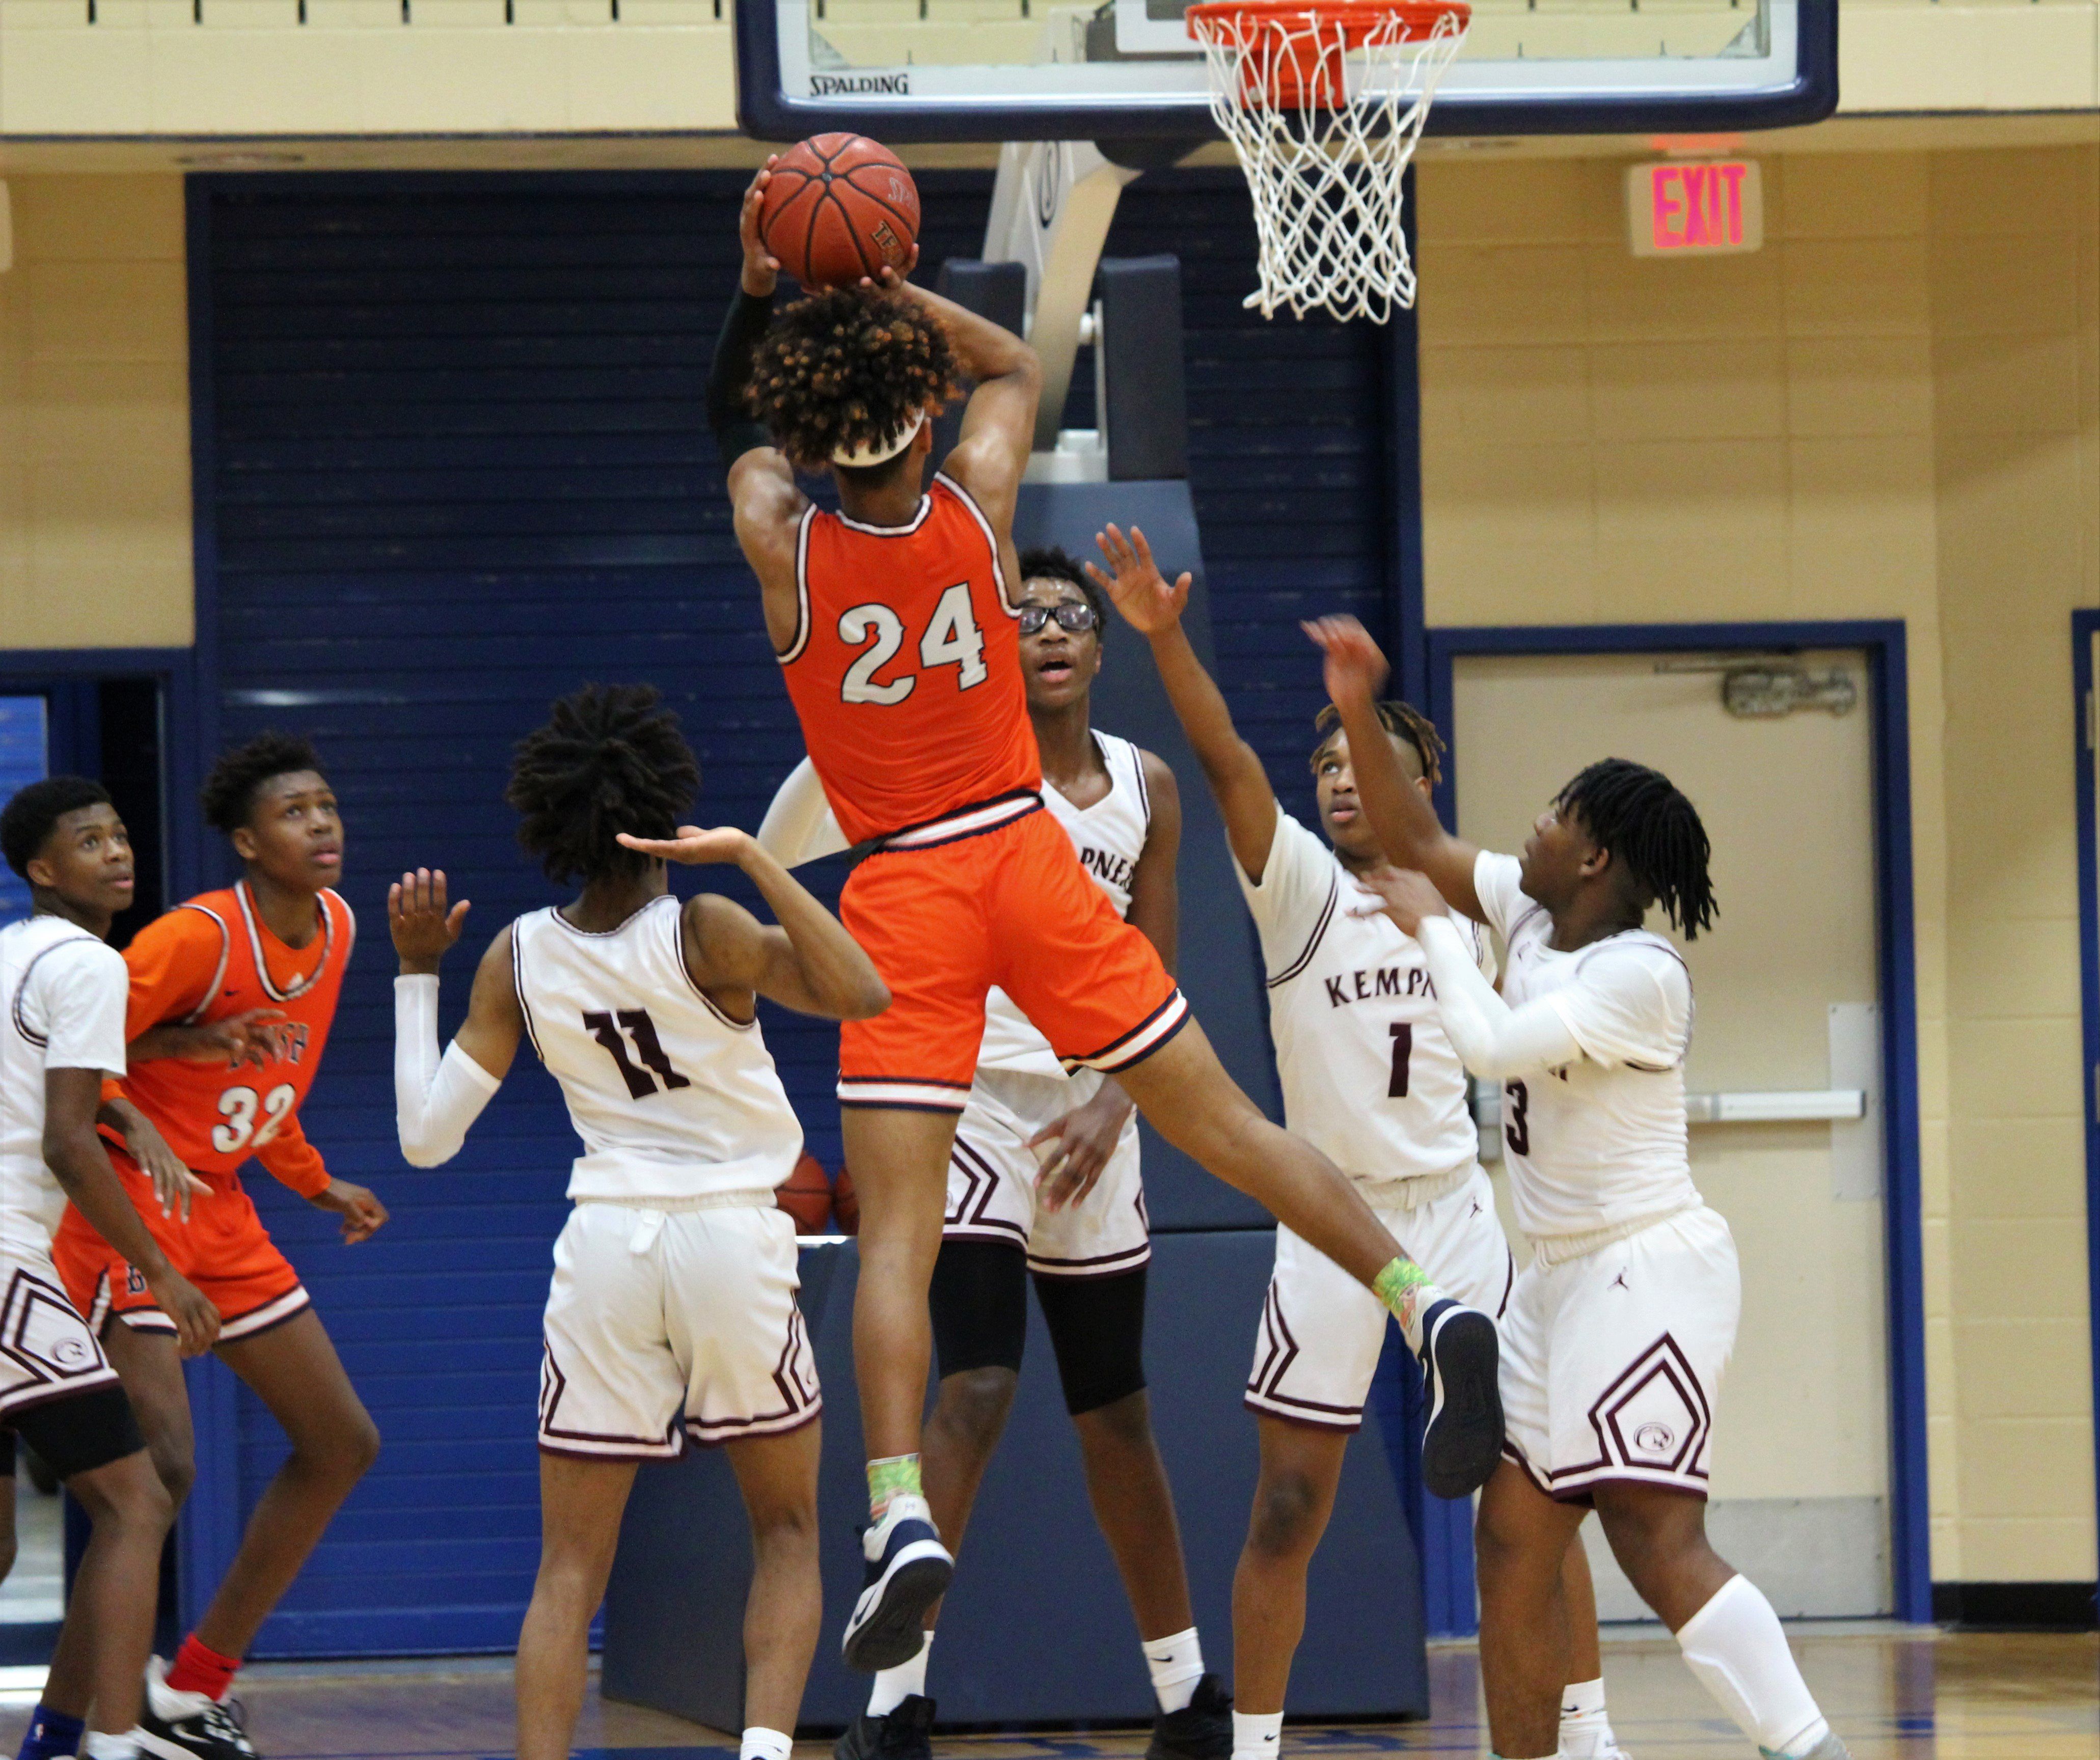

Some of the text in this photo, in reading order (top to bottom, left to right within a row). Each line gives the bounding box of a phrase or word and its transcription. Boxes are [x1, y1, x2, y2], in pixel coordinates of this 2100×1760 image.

[810, 73, 909, 96] SPALDING
[1652, 163, 1747, 249] EXIT
[838, 581, 988, 706] 24
[582, 1007, 691, 1099] 11
[1388, 1022, 1412, 1097] 1
[211, 1082, 296, 1153] 32
